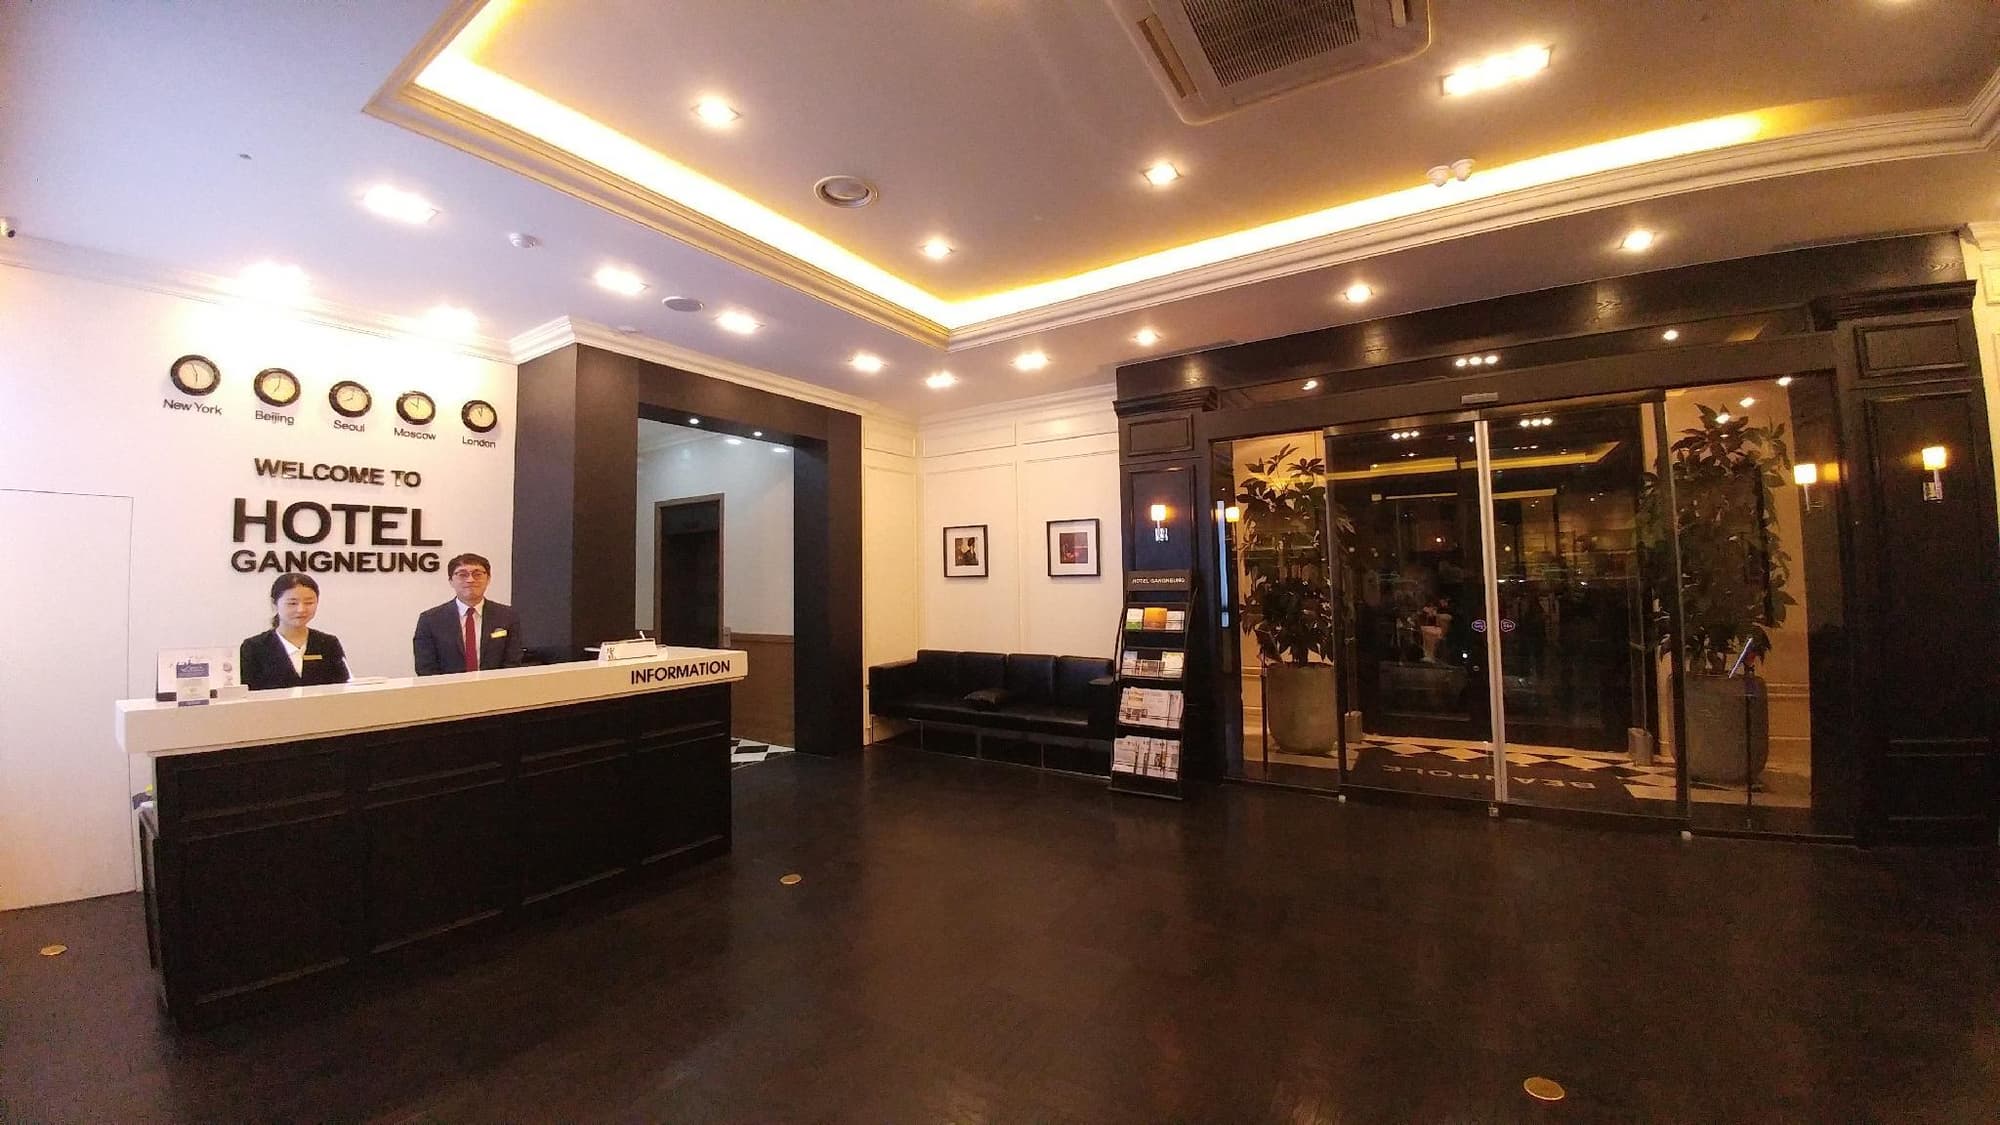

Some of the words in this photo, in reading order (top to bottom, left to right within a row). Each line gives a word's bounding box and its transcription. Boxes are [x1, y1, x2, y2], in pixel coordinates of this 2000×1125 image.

[163, 398, 192, 411] New
[194, 402, 223, 416] York
[255, 410, 295, 425] Beijing
[333, 420, 365, 432] Seoul
[394, 427, 437, 440] Moscow
[462, 436, 496, 449] London
[254, 457, 384, 485] WELCOME
[391, 470, 421, 488] TO
[233, 498, 443, 546] HOTEL
[231, 549, 440, 573] GANGNEUNG
[631, 660, 730, 684] INFORMATION
